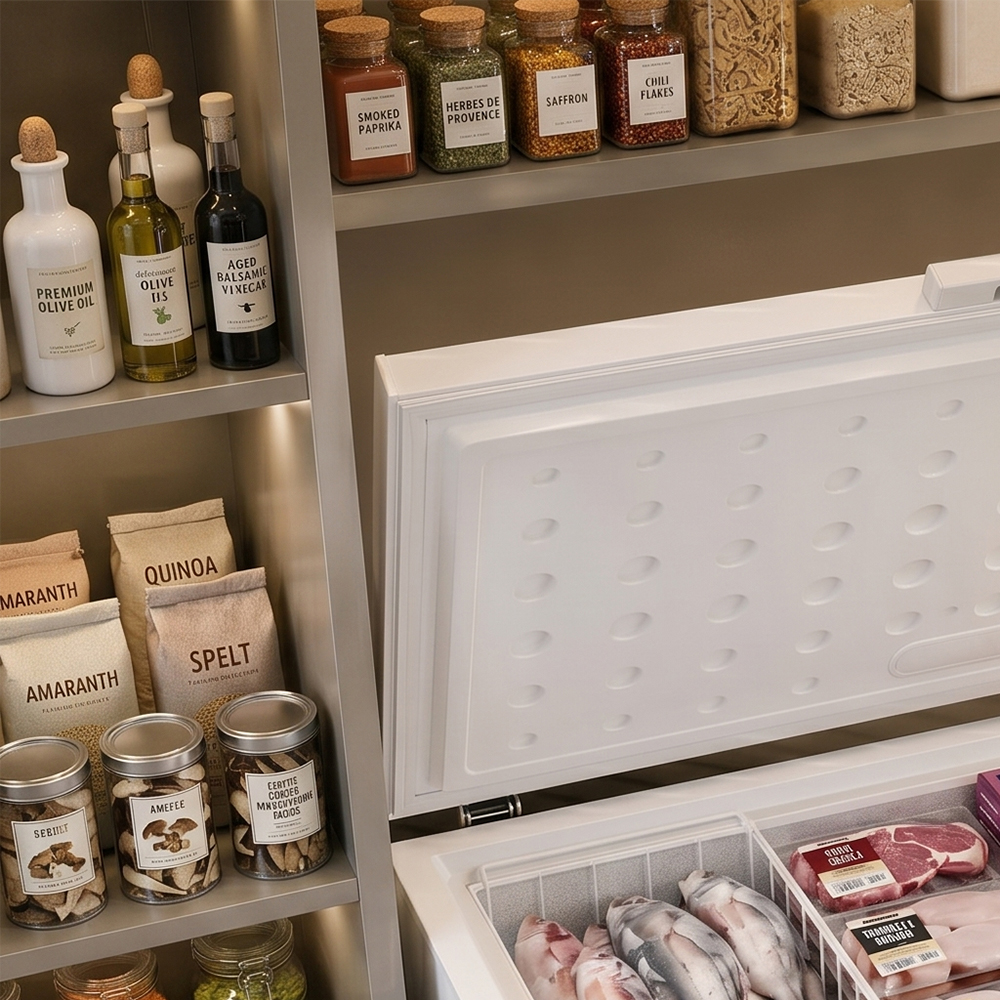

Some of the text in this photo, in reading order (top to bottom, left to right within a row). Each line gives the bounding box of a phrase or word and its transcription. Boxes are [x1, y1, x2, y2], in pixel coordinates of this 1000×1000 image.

[546, 93, 588, 107] SAFFRON
[640, 86, 674, 100] FLAKES
[446, 96, 500, 112] HERBES DE
[357, 108, 400, 123] SMOKED
[447, 109, 501, 125] PROVENCE
[358, 121, 402, 135] PAPRIKA
[227, 256, 257, 270] AGED
[36, 280, 94, 300] PREMIUM
[140, 276, 174, 291] OLIVE
[38, 295, 95, 313] OLIVE OIL
[144, 555, 218, 587] QUINOA
[189, 642, 250, 673] SPELT
[26, 669, 119, 704] AMARANTH
